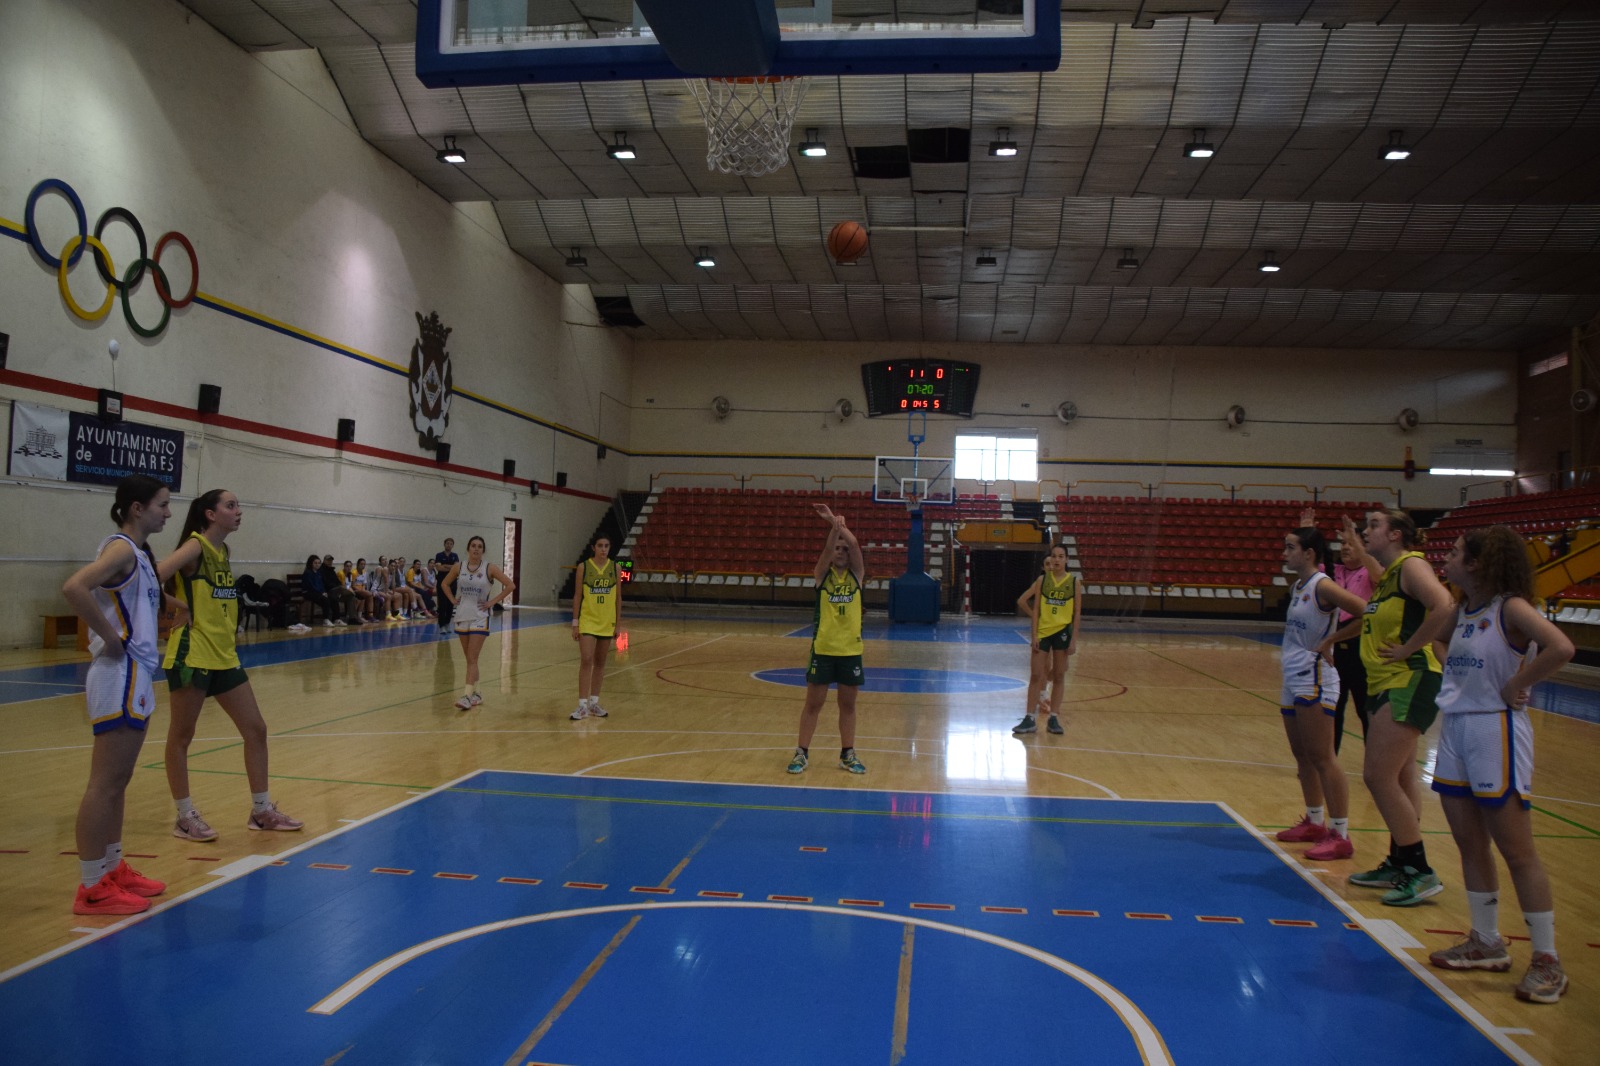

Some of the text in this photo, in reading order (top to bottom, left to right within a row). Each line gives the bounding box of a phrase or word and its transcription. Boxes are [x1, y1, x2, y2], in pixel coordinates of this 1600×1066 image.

[936, 368, 943, 379] 0
[907, 384, 934, 394] 07:20
[76, 425, 177, 456] AYUNTAMIENTO
[75, 444, 175, 472] de LINARES
[75, 464, 105, 475] SERVICIO
[593, 578, 610, 588] CAB
[596, 596, 605, 604] 10
[1049, 590, 1065, 600] CAB
[838, 605, 846, 616] 11
[1051, 607, 1058, 615] 6
